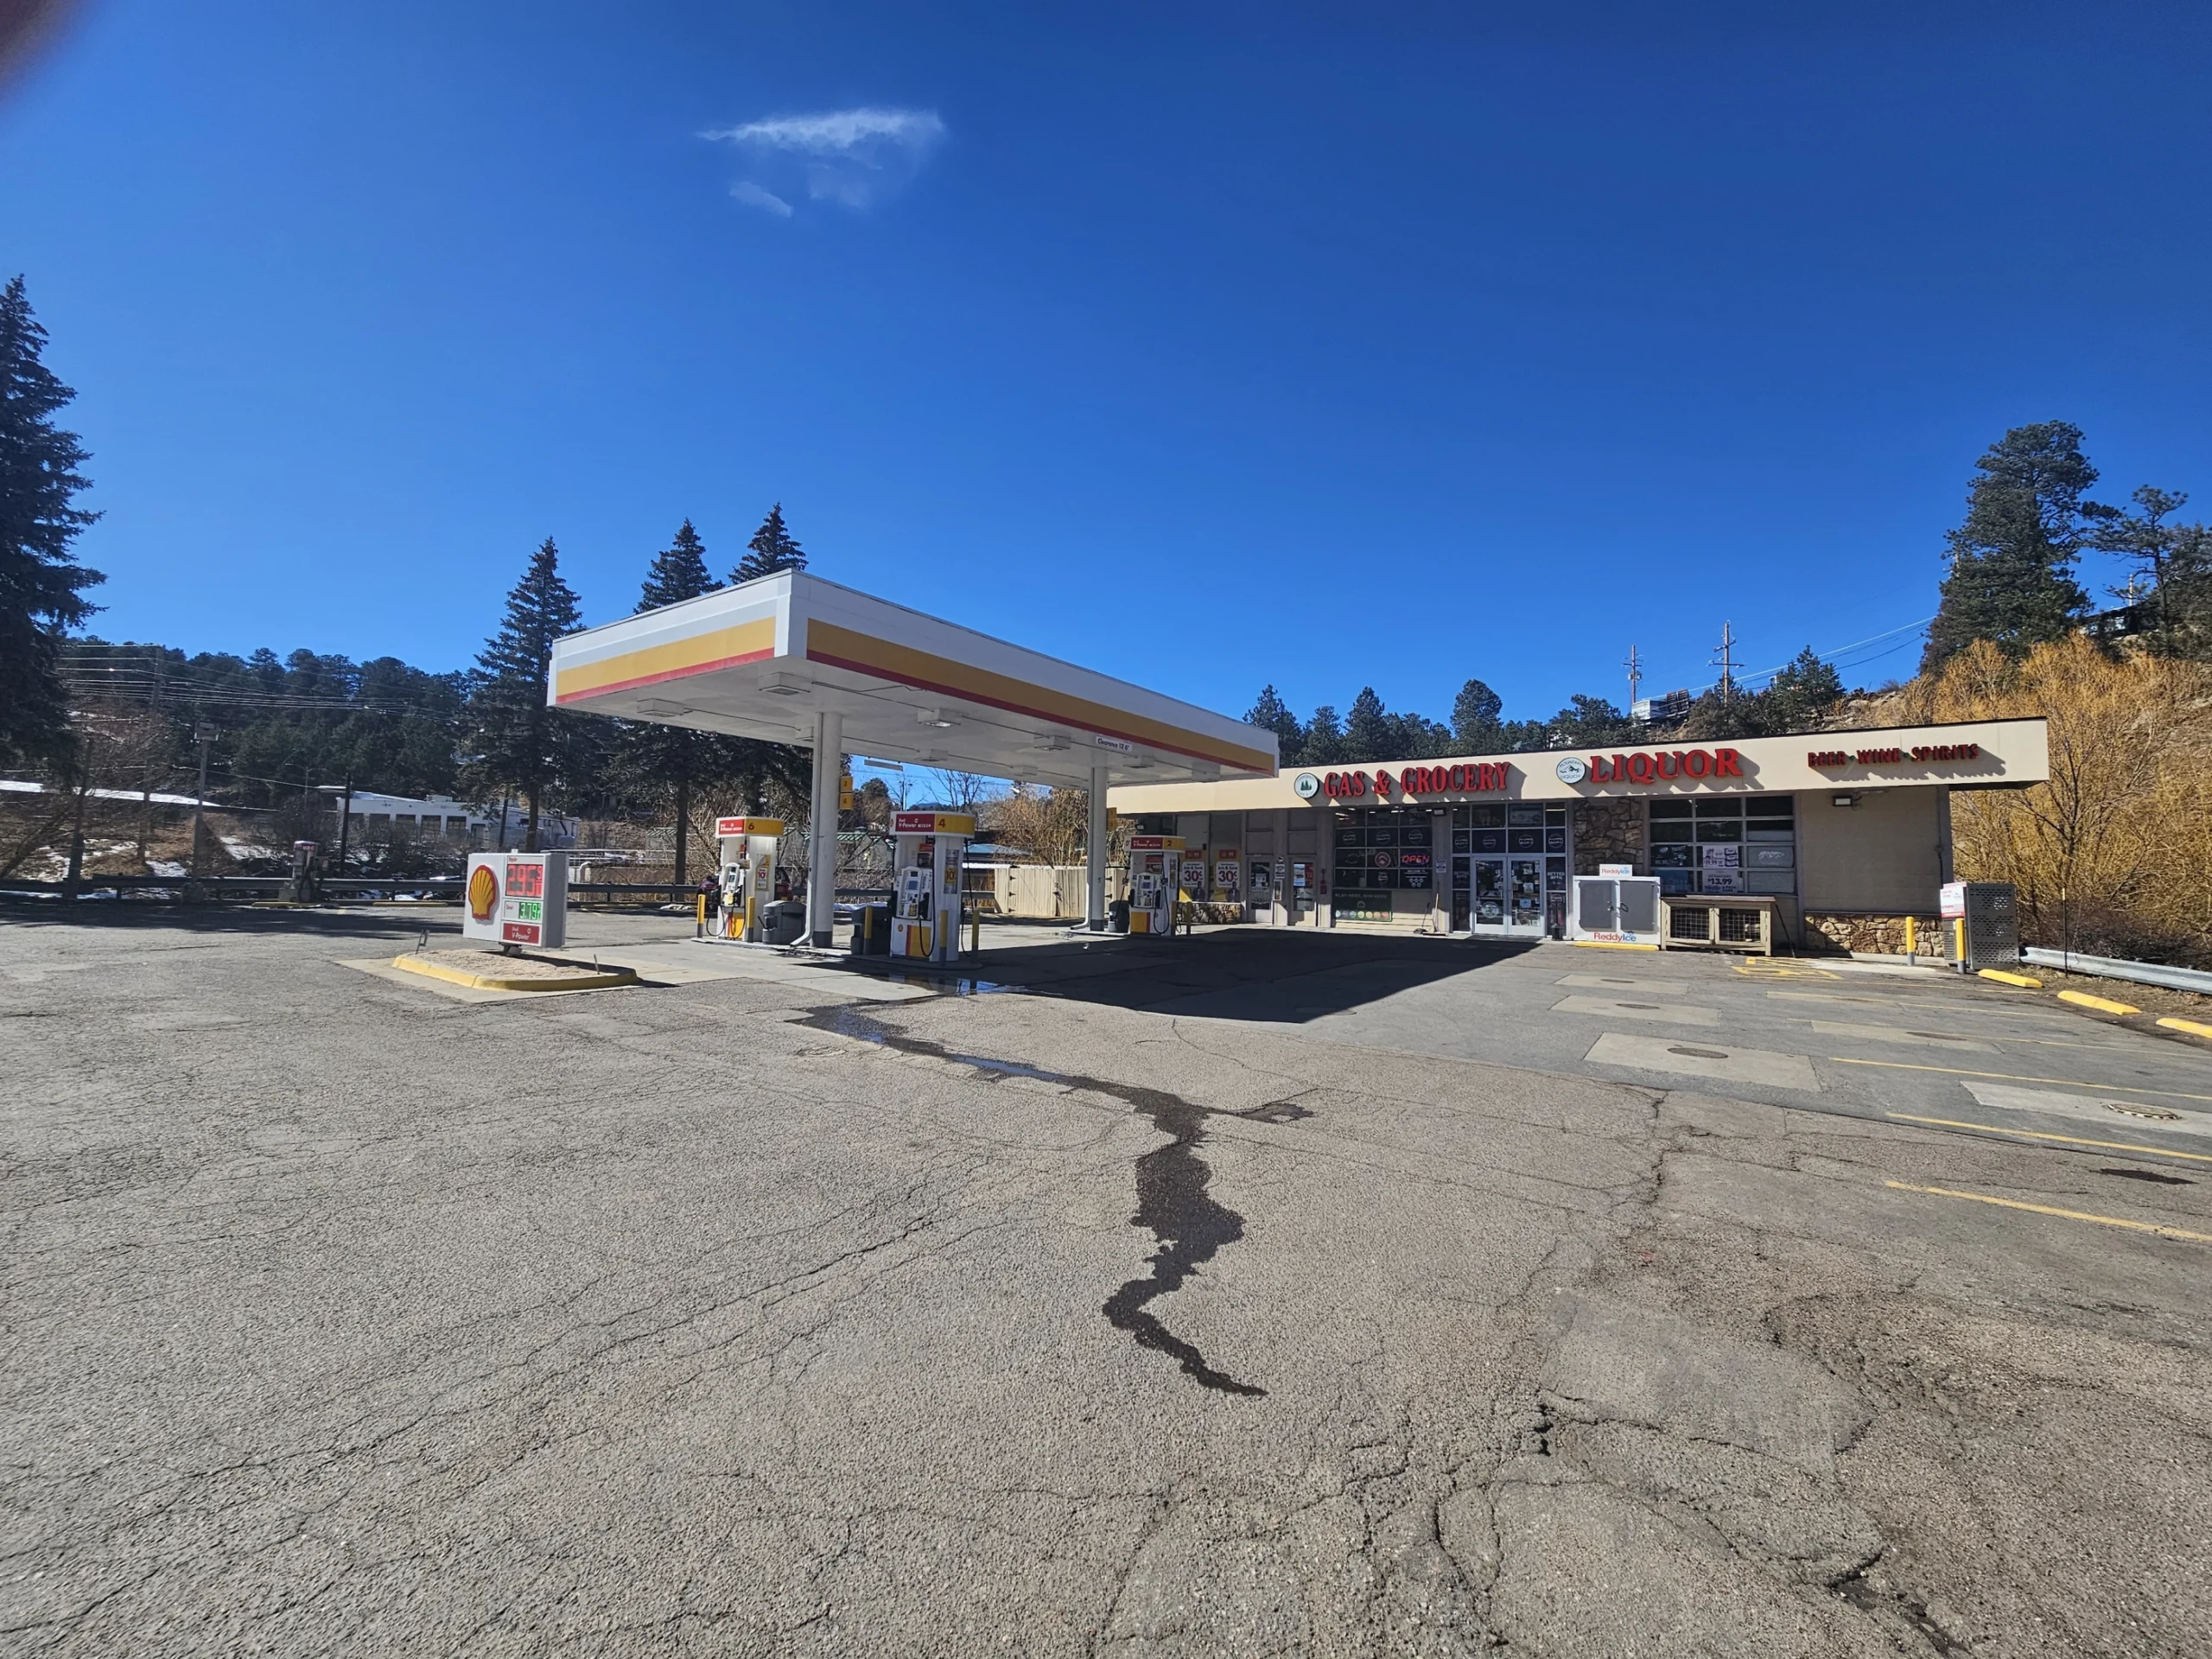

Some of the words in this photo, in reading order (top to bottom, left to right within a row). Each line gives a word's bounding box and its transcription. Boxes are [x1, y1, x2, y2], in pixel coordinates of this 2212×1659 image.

[1097, 738, 1118, 748] Clearance
[1808, 750, 1847, 766] BEER
[1856, 747, 1902, 765] WINE
[1910, 743, 1980, 762] SPIRITS
[1589, 747, 1744, 785] LIQUOR
[1323, 770, 1366, 798] GAS
[1372, 769, 1390, 796] &
[1400, 761, 1510, 794] GROCERY
[747, 822, 755, 830] 6
[938, 818, 946, 828] 4
[1402, 855, 1430, 864] OPEN
